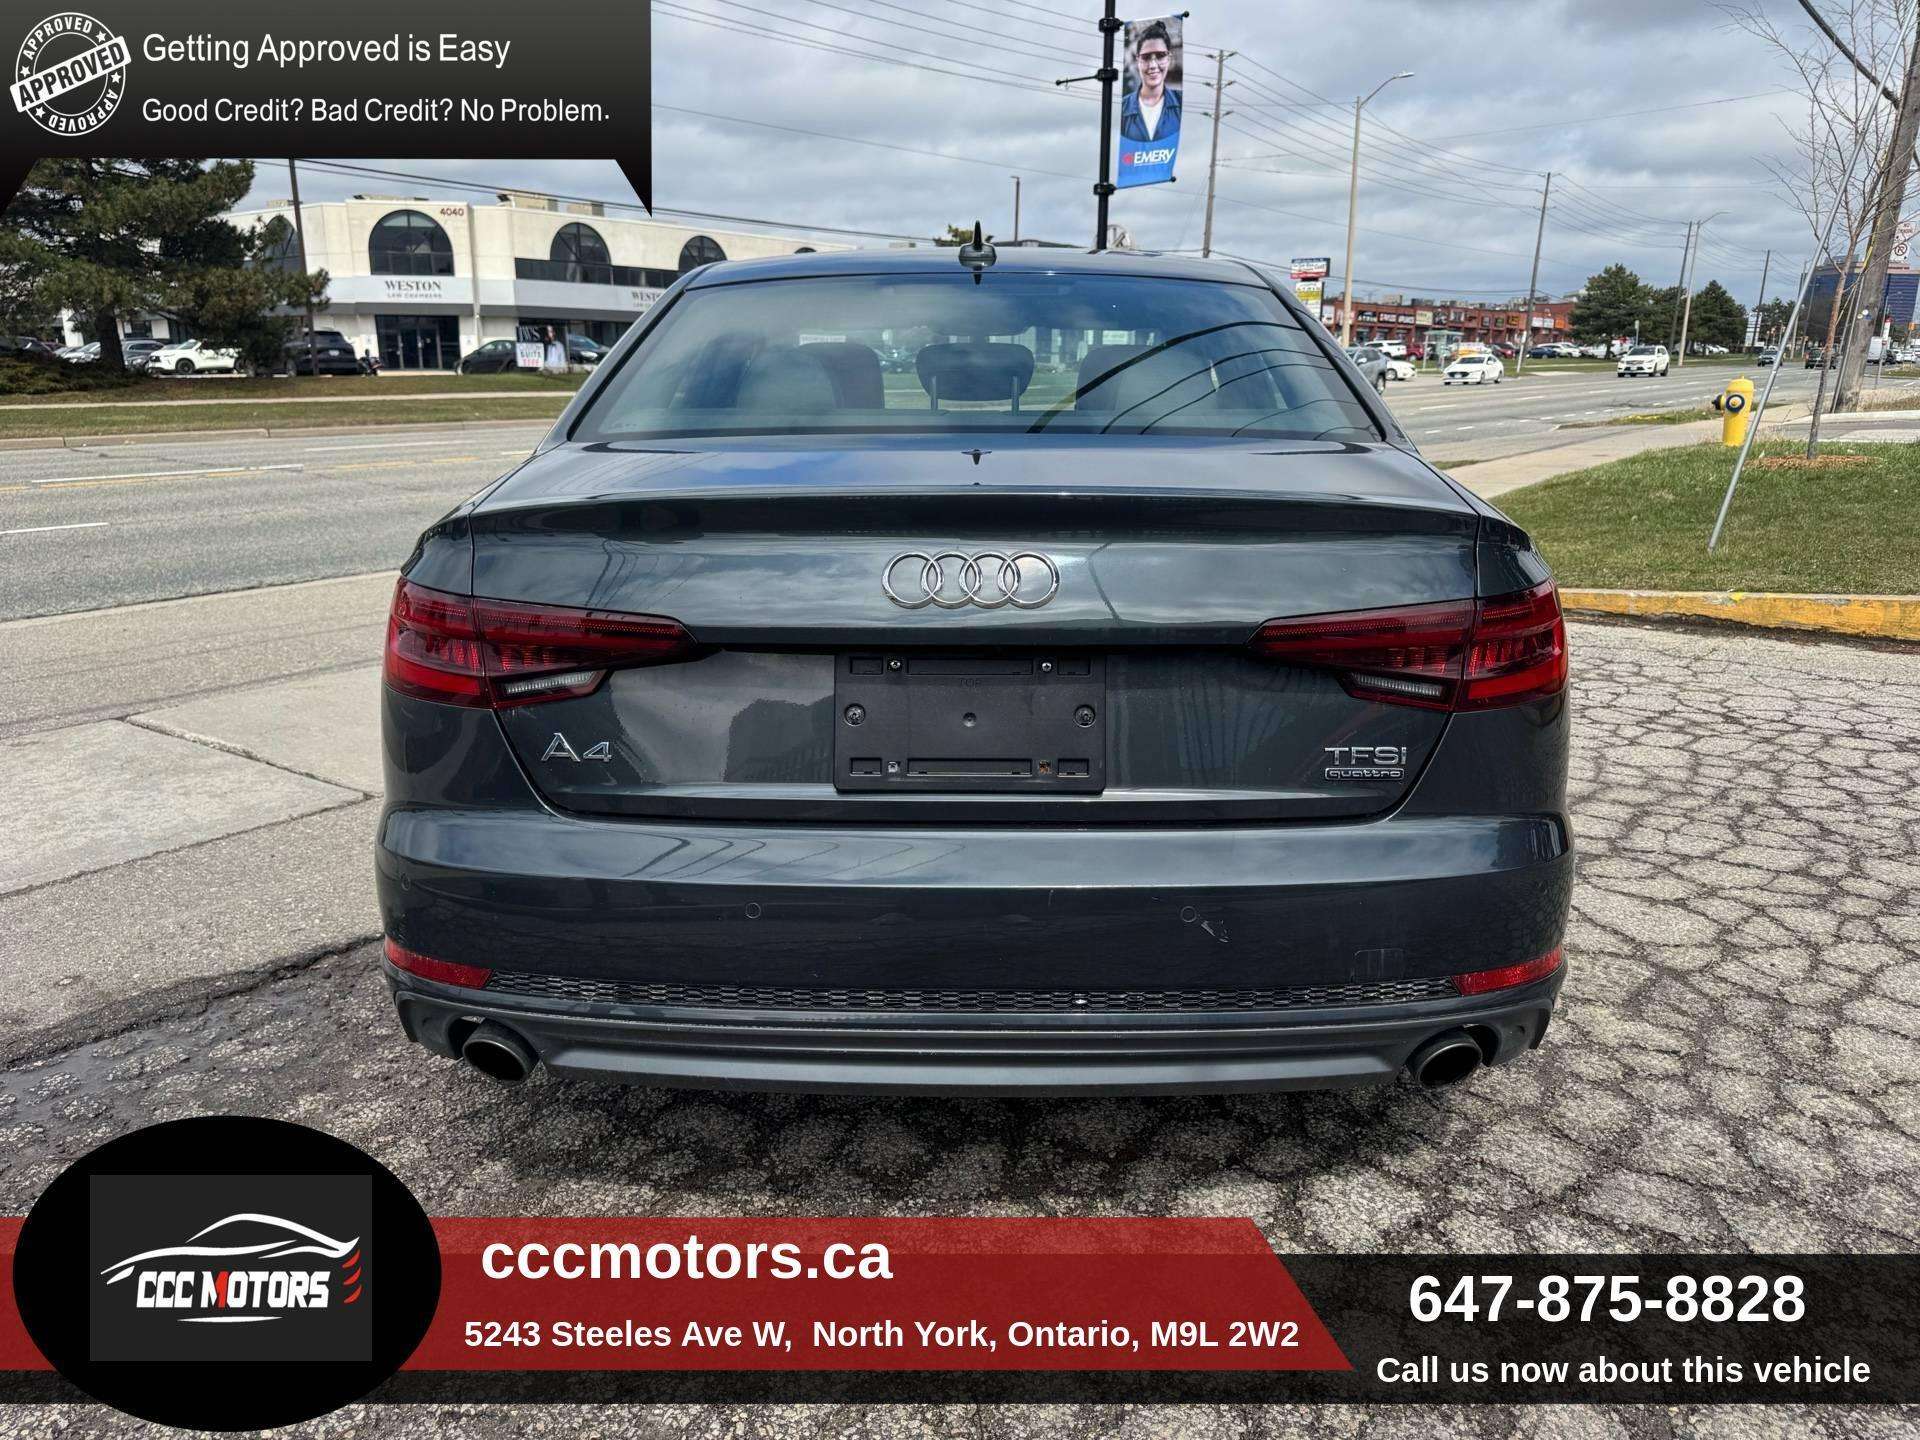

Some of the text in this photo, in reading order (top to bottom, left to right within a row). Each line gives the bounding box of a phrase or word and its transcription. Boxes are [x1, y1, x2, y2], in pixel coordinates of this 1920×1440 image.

[1134, 148, 1175, 164] EMERY
[440, 207, 464, 217] 4040
[385, 280, 441, 291] WESTON
[541, 732, 612, 762] A4
[1329, 769, 1401, 779] quattro
